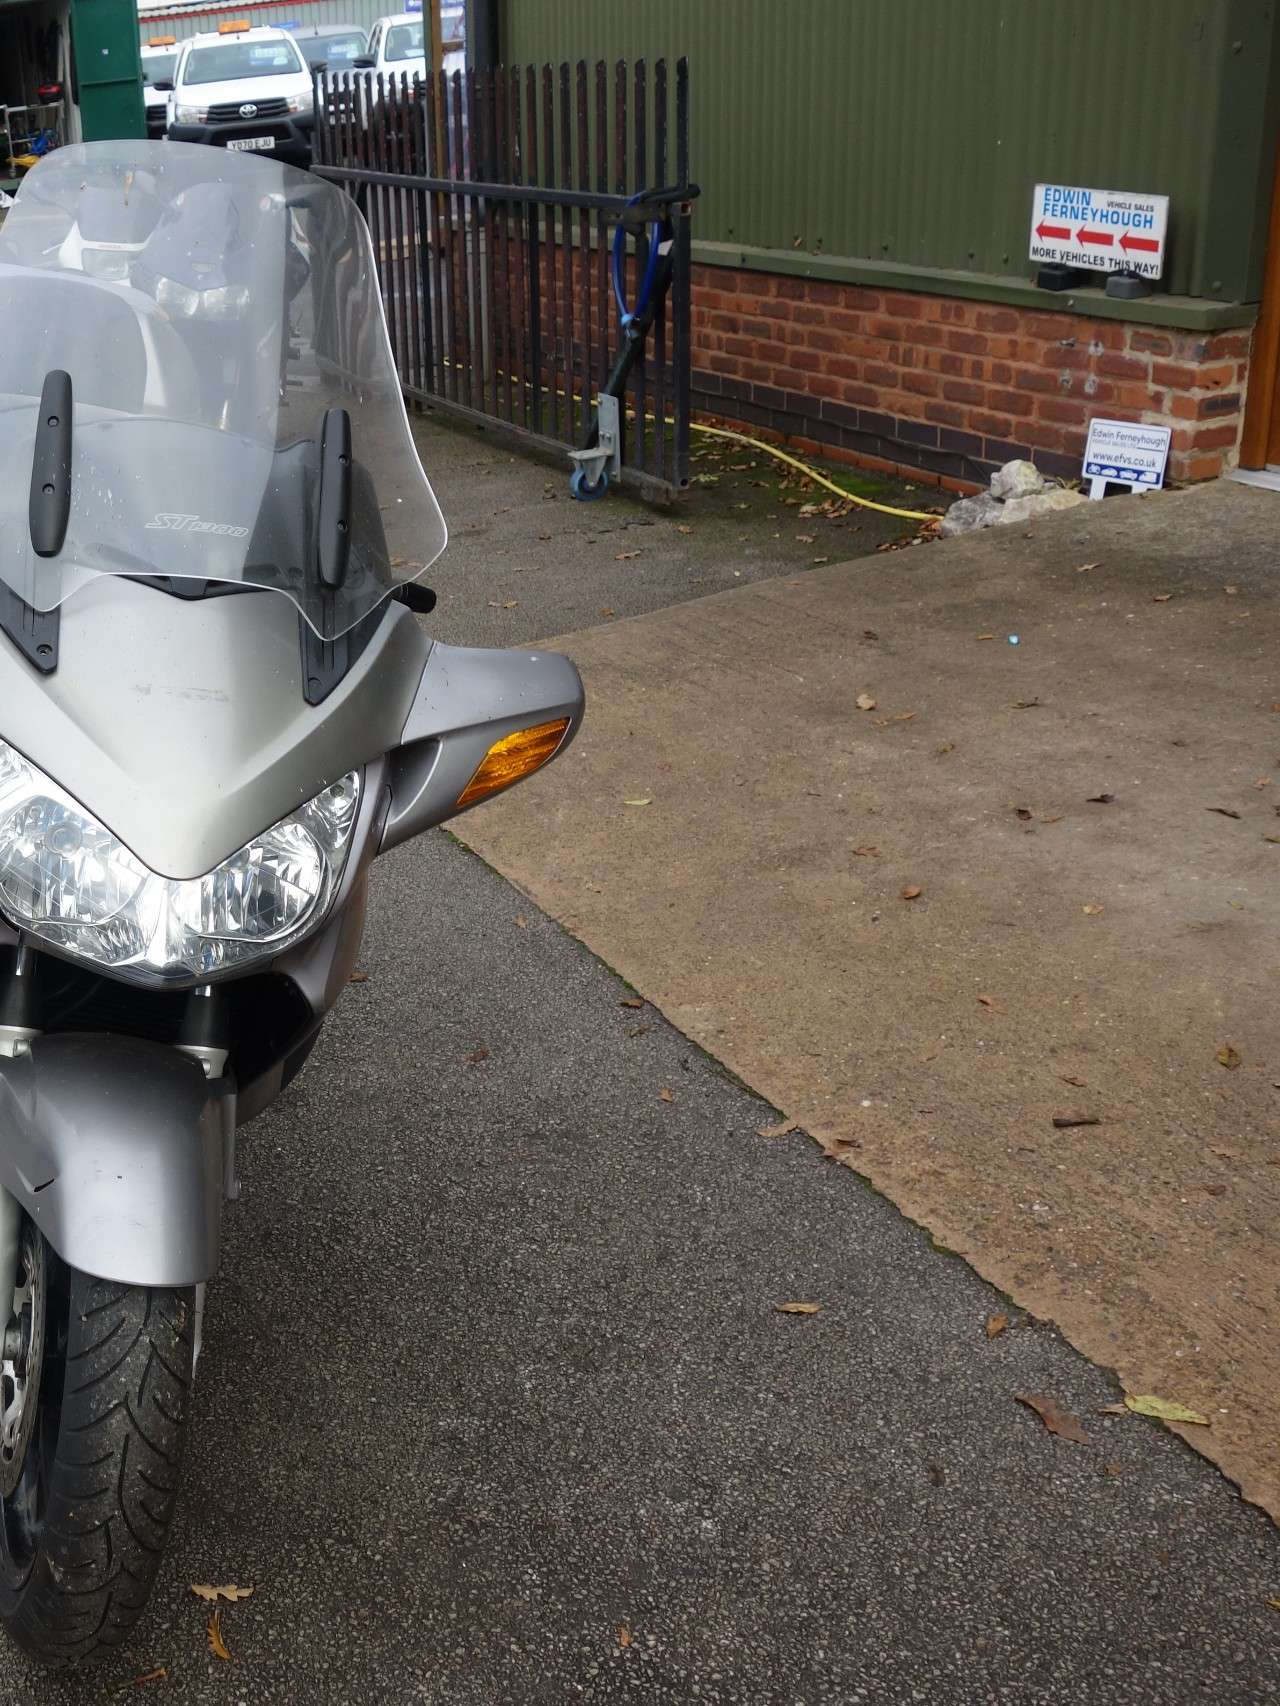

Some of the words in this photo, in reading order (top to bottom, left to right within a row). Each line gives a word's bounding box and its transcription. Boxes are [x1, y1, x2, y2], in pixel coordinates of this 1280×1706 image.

[255, 138, 271, 149] EJU
[1045, 187, 1092, 206] EDWIN
[1043, 203, 1153, 229] FERNEYHOUGH
[1106, 201, 1132, 211] VEHICLE
[1134, 203, 1154, 212] SALES
[1032, 246, 1057, 258] MORE
[1060, 251, 1105, 267] VEHICLES
[1108, 257, 1131, 270] THIS
[1134, 261, 1159, 275] WAY!
[1092, 428, 1115, 438] Edwin
[1116, 431, 1166, 448] Ferneyhough
[1093, 452, 1156, 468] www.efvs.co.uk
